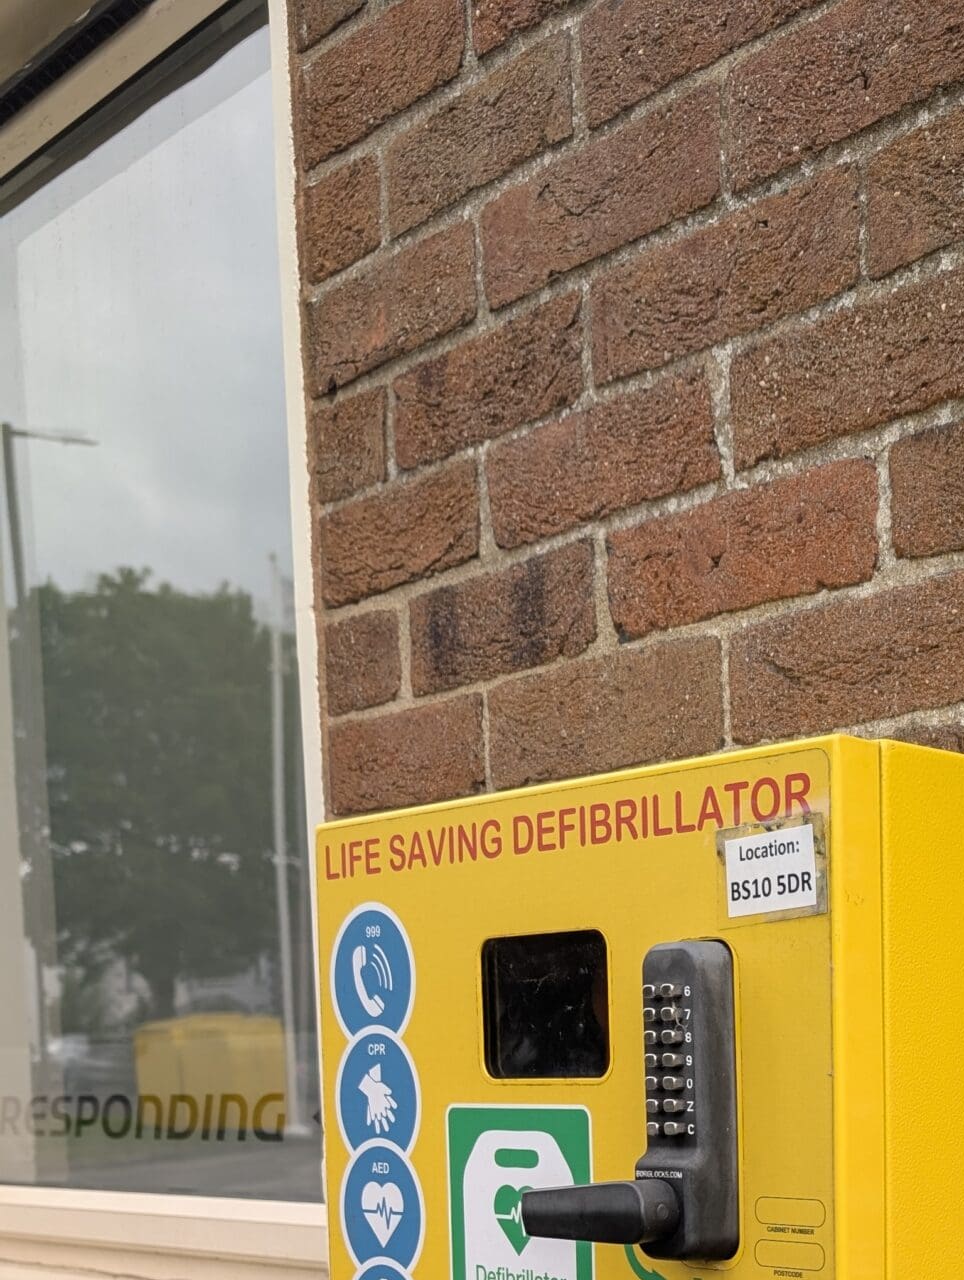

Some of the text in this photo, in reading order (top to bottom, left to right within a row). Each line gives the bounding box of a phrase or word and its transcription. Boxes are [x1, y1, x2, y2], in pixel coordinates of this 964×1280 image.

[325, 772, 811, 880] LIFE SAVING DEFIBRILLATOR
[739, 839, 800, 862] Location:
[731, 871, 812, 901] BS10 5DR
[365, 925, 381, 938] 999
[684, 986, 691, 997] 6
[684, 1009, 691, 1020] 7
[685, 1032, 692, 1043] 8
[368, 1043, 386, 1056] CPR
[686, 1055, 693, 1066] 9
[687, 1101, 694, 1112] Z
[687, 1124, 695, 1135] C
[372, 1162, 389, 1174] AED
[773, 1270, 803, 1278] POSTCODE
